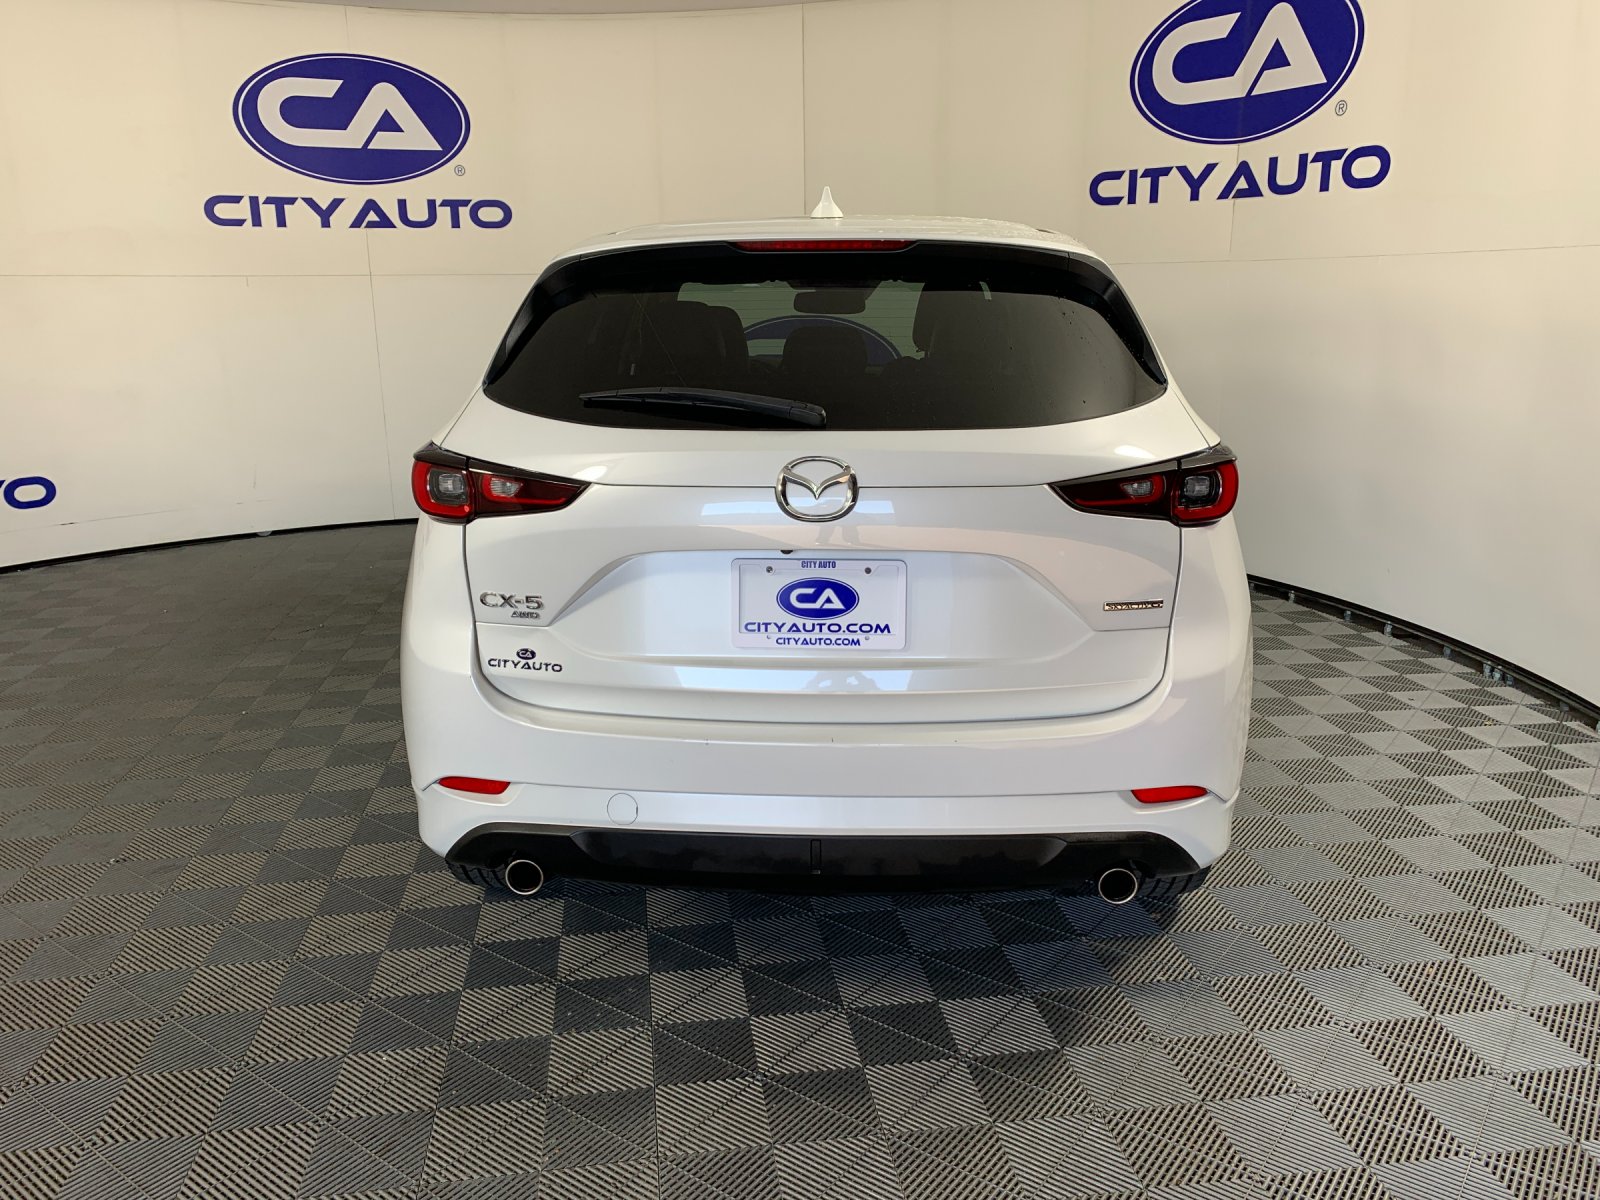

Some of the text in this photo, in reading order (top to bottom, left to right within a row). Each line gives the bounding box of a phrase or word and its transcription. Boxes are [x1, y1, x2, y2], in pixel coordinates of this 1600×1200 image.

[1152, 1, 1327, 106] CA
[257, 76, 443, 151] CA
[801, 560, 837, 569] CITY AUTO
[479, 591, 544, 611] CX-5
[789, 587, 846, 610] CA
